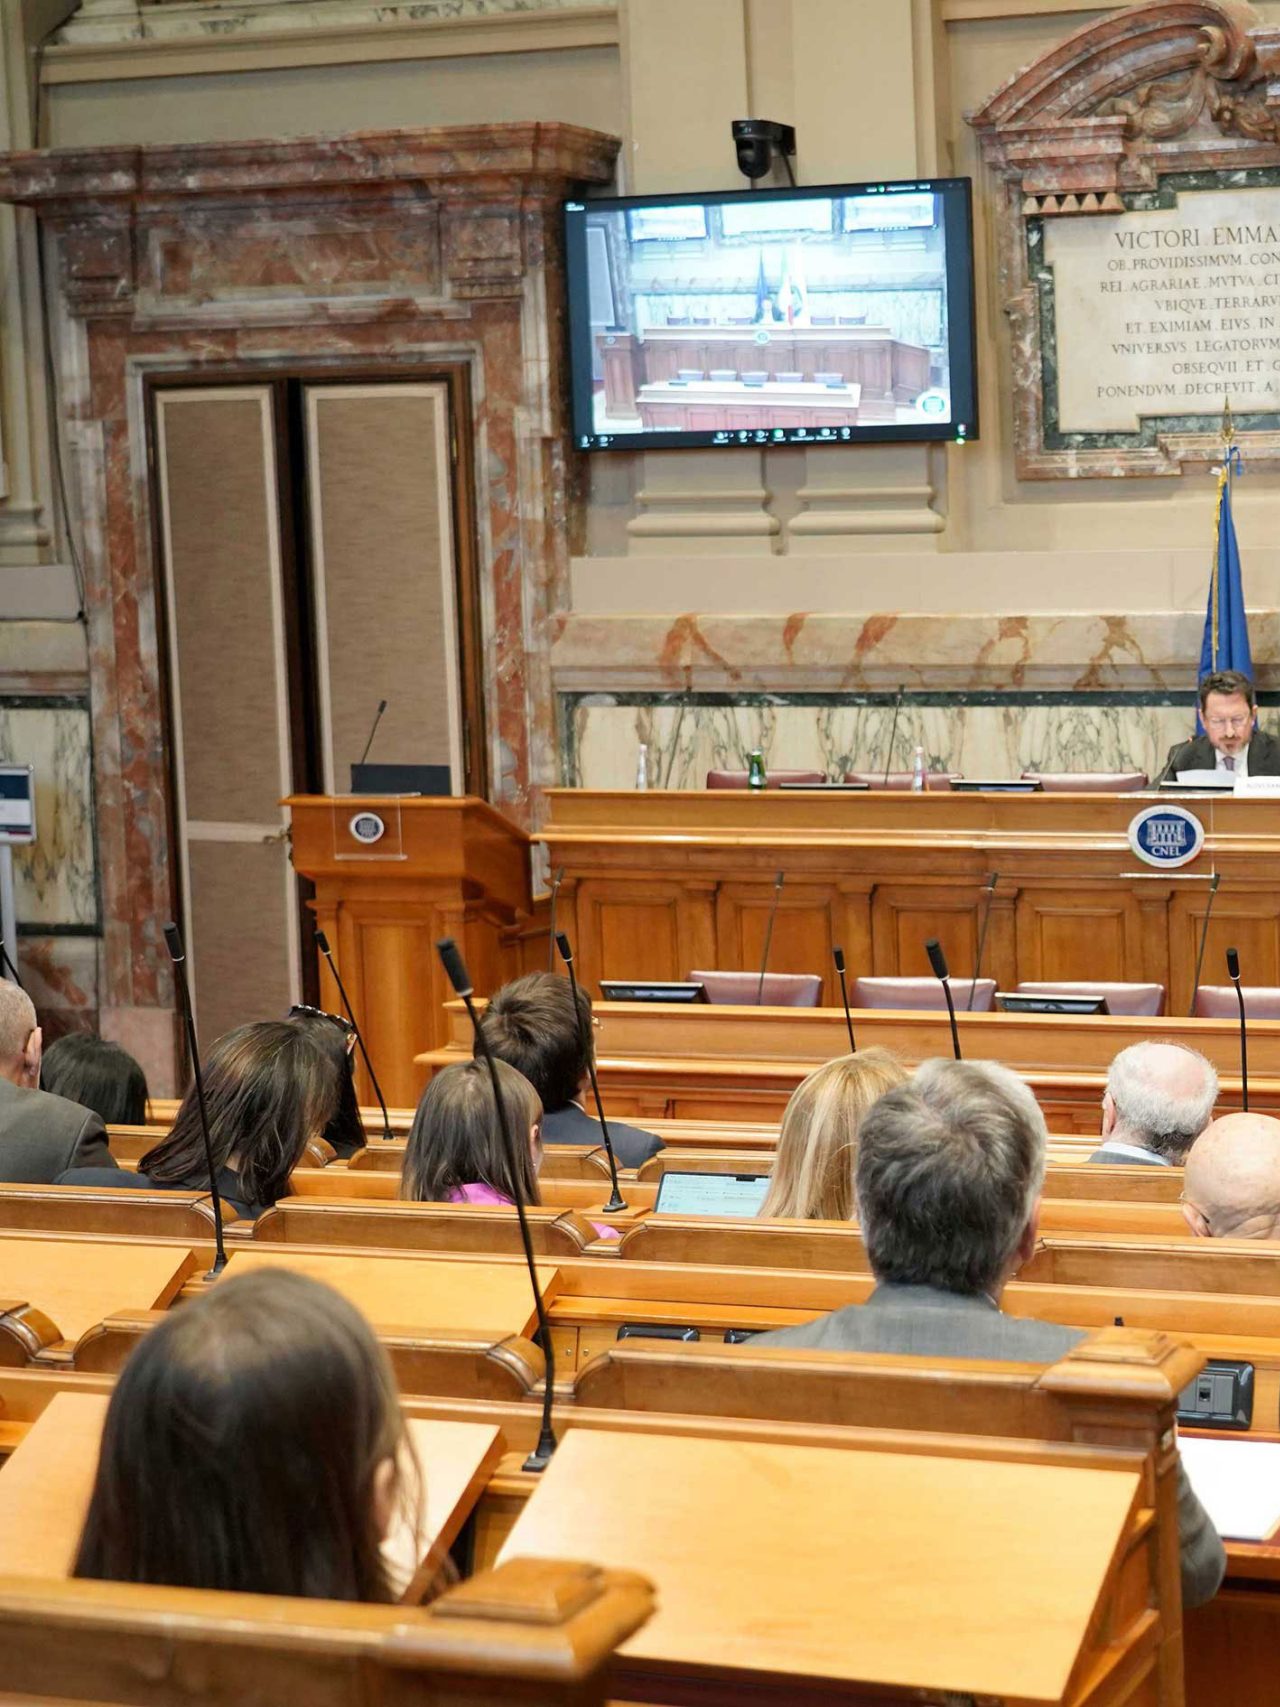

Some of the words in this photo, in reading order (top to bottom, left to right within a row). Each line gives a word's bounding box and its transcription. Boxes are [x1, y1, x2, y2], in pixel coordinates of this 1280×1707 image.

[1115, 229, 1199, 249] VICTORI
[1133, 254, 1242, 270] PROVIDISSIMVM
[1100, 281, 1122, 293] REI
[1130, 277, 1200, 291] AGRARIAE
[1209, 276, 1254, 287] MVTVA
[1155, 298, 1206, 313] VBIQVE
[1126, 323, 1141, 334] ET
[1151, 320, 1211, 333] EXIMIAM
[1221, 319, 1250, 330] EIVS
[1260, 317, 1274, 328] IN
[1112, 342, 1186, 354] VNIVERSVS
[1196, 338, 1280, 352] LEGATORVM
[1172, 362, 1237, 375] OBSEQVII
[1247, 360, 1261, 372] ET
[1097, 384, 1175, 397] PONENDVM
[1185, 381, 1255, 395] DECREVIT
[1151, 845, 1182, 857] CNEL
